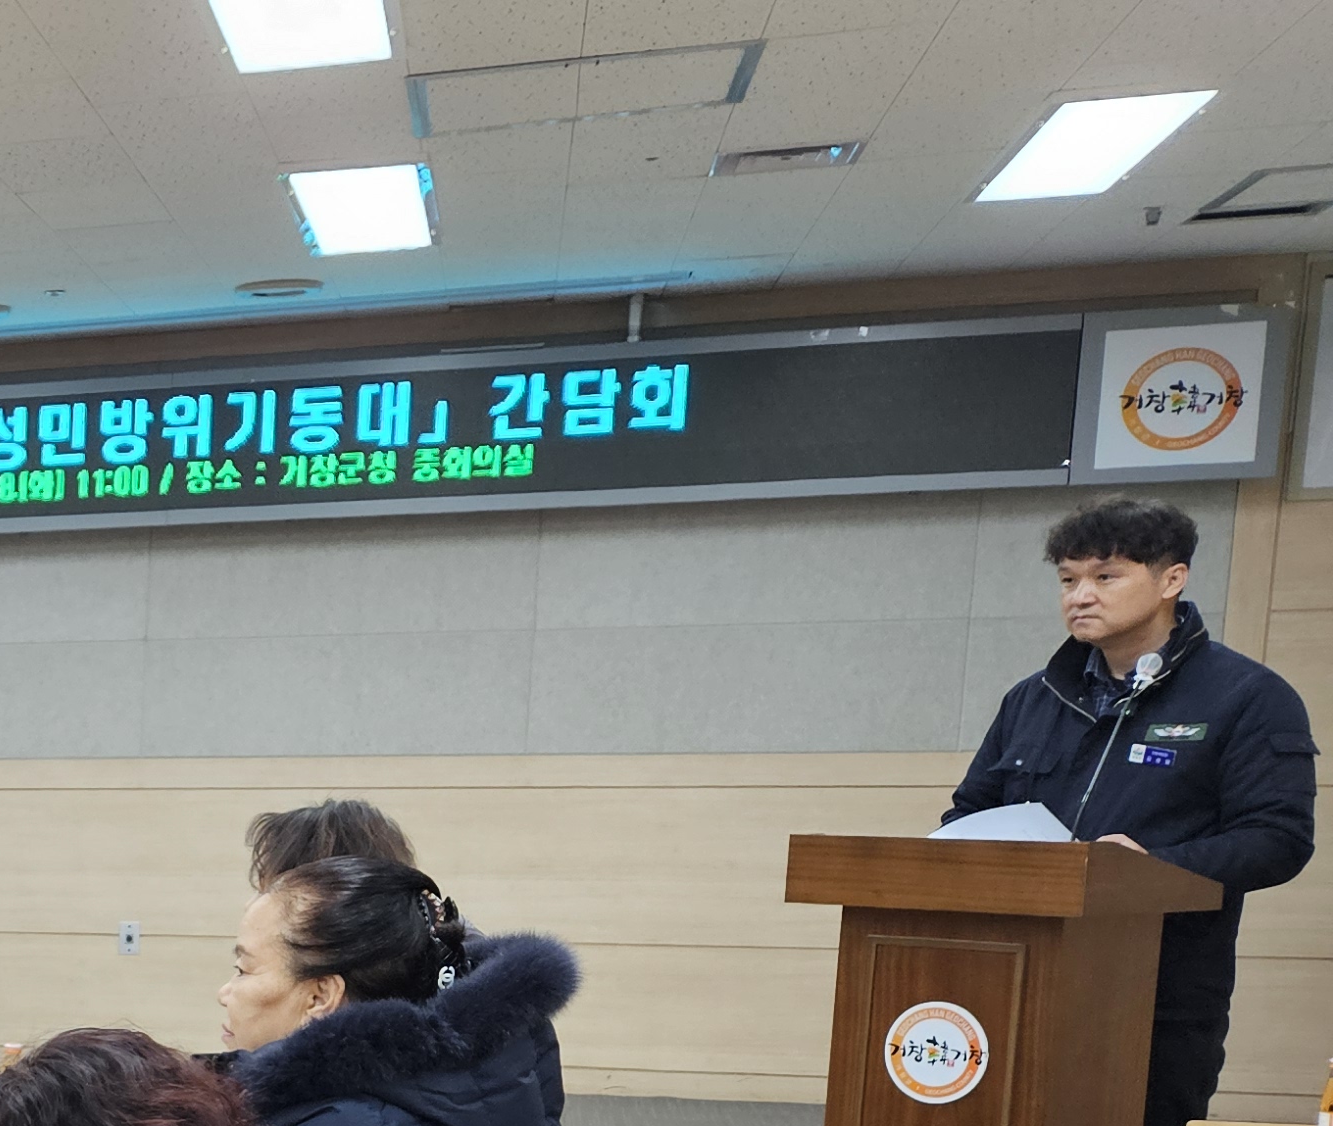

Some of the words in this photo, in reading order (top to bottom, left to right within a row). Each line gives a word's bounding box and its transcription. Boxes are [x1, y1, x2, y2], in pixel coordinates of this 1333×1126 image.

[490, 363, 690, 441] 간담회
[77, 464, 149, 499] 11:00
[186, 459, 242, 494] 장소
[279, 449, 397, 488] 거창군청
[412, 443, 534, 483] 중회의실
